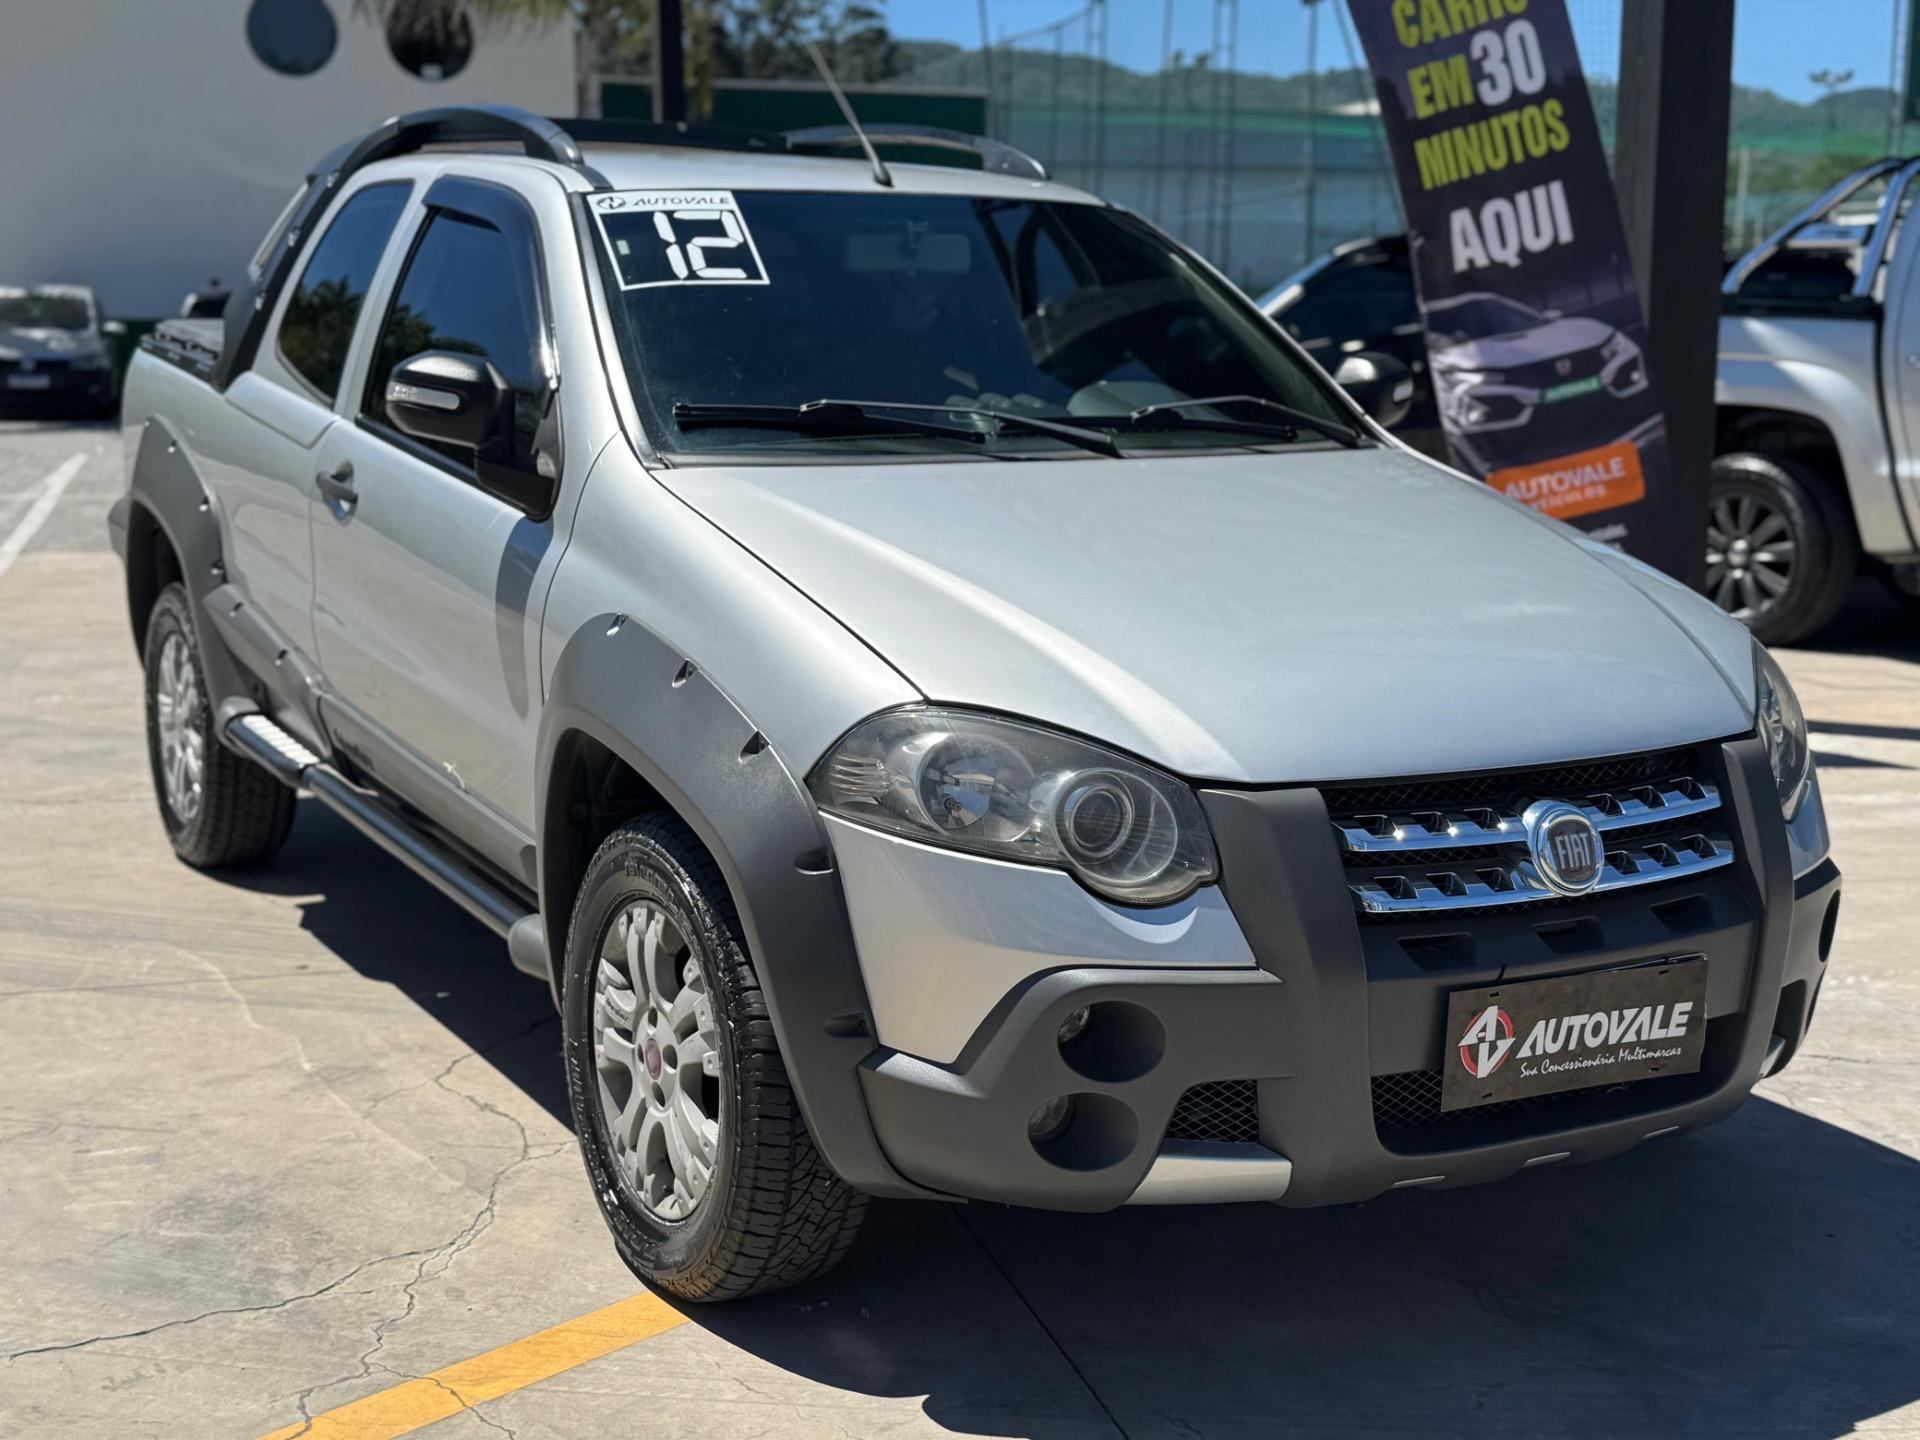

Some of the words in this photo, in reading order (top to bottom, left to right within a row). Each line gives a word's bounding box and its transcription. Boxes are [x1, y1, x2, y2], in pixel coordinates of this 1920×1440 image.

[1391, 0, 1528, 48] CAR
[1407, 54, 1475, 120] EM
[1470, 19, 1546, 106] 30
[1413, 99, 1570, 190] MINUTOS
[633, 197, 731, 206] AUTOVALE
[1449, 180, 1574, 273] AQUI
[653, 210, 747, 279] 12
[1505, 456, 1626, 499] AUTOVALE
[1554, 832, 1591, 870] FIAT
[1515, 1001, 1694, 1059] AUTOVALE
[1519, 1062, 1538, 1078] Sua
[1541, 1052, 1616, 1074] Concessionária
[1618, 1045, 1682, 1063] Multimarcas
